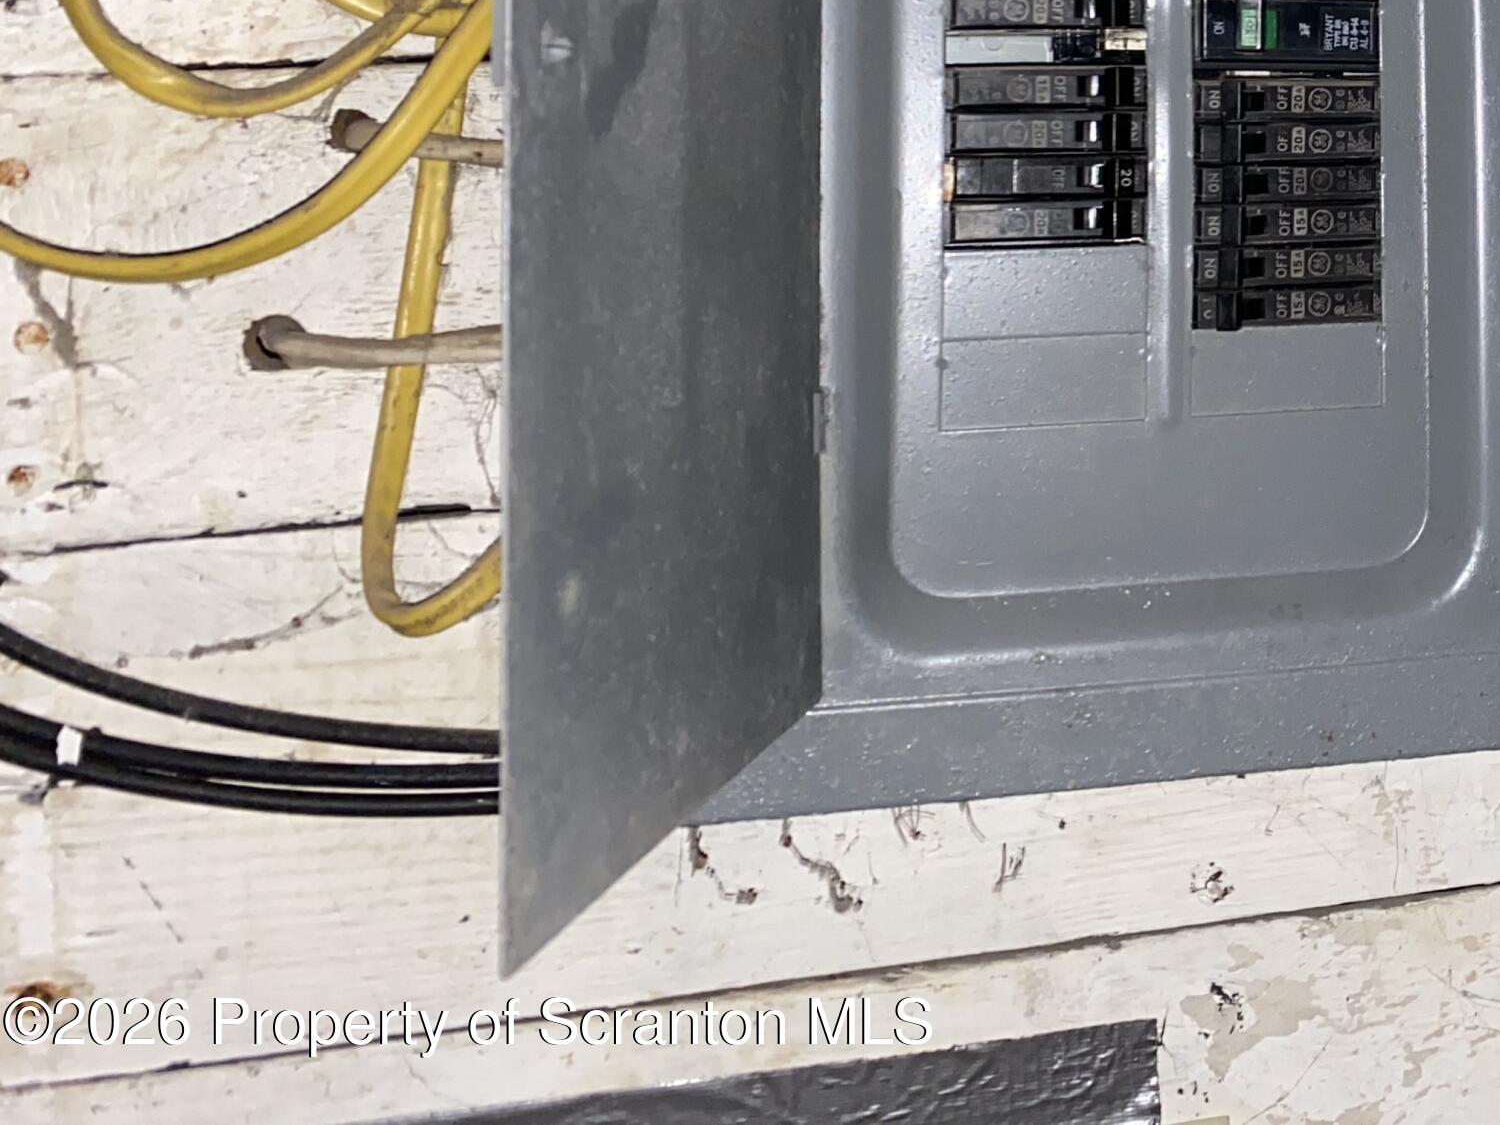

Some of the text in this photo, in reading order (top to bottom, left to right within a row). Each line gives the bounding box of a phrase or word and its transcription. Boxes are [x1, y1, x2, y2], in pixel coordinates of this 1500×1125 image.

[1213, 21, 1225, 36] ON
[1323, 13, 1334, 51] BRYANT
[1349, 37, 1358, 50] CU
[1359, 37, 1369, 49] AL
[1037, 79, 1048, 101] 15A
[1054, 75, 1066, 101] OFF
[1209, 90, 1221, 108] ON
[1277, 86, 1288, 110] OFF
[1294, 87, 1303, 110] 20A
[1034, 123, 1045, 146] 20A
[1051, 120, 1062, 147] OFF
[1294, 129, 1303, 151] 20A
[1121, 168, 1132, 187] 20
[1208, 172, 1219, 192] ON
[1278, 167, 1290, 193] OFF
[1295, 169, 1305, 192] 20A
[1036, 211, 1047, 235] 20A
[1208, 215, 1220, 236] ON
[1279, 209, 1290, 236] OFF
[1296, 210, 1306, 232] 15A
[1204, 258, 1216, 279] ON
[1276, 251, 1287, 278] OFF
[1293, 252, 1303, 274] 15A
[1276, 292, 1287, 318] OFF
[1293, 293, 1303, 315] 15A
